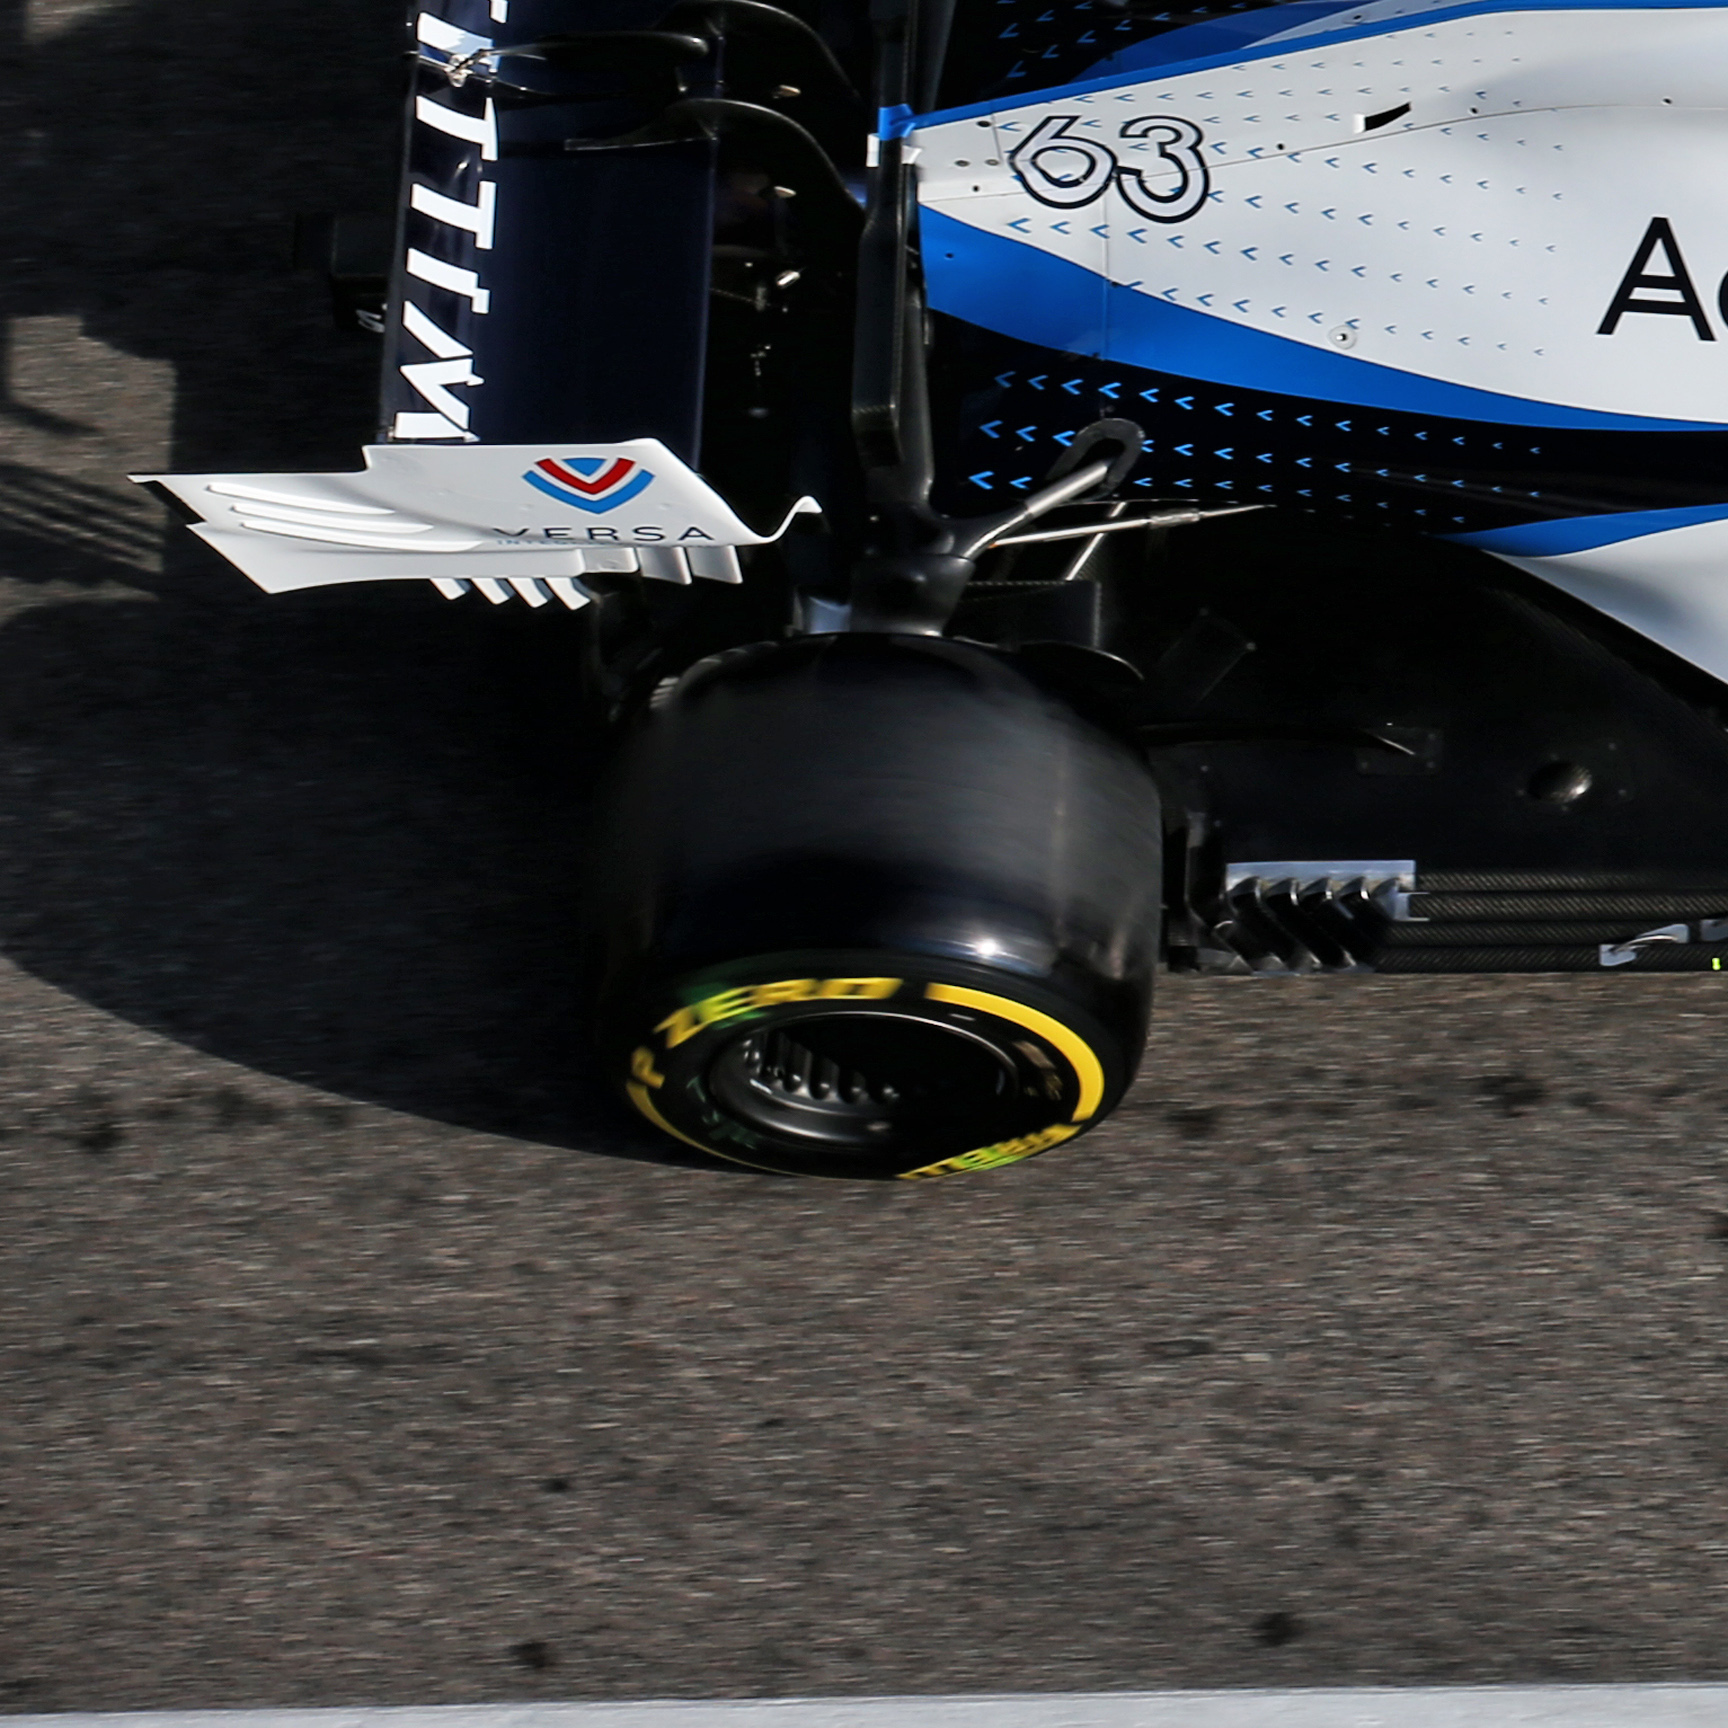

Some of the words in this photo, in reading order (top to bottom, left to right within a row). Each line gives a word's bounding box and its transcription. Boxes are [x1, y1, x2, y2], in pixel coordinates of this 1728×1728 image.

[1010, 115, 1211, 224] 63
[493, 526, 715, 542] VERSA
[653, 976, 905, 1049] ZERO
